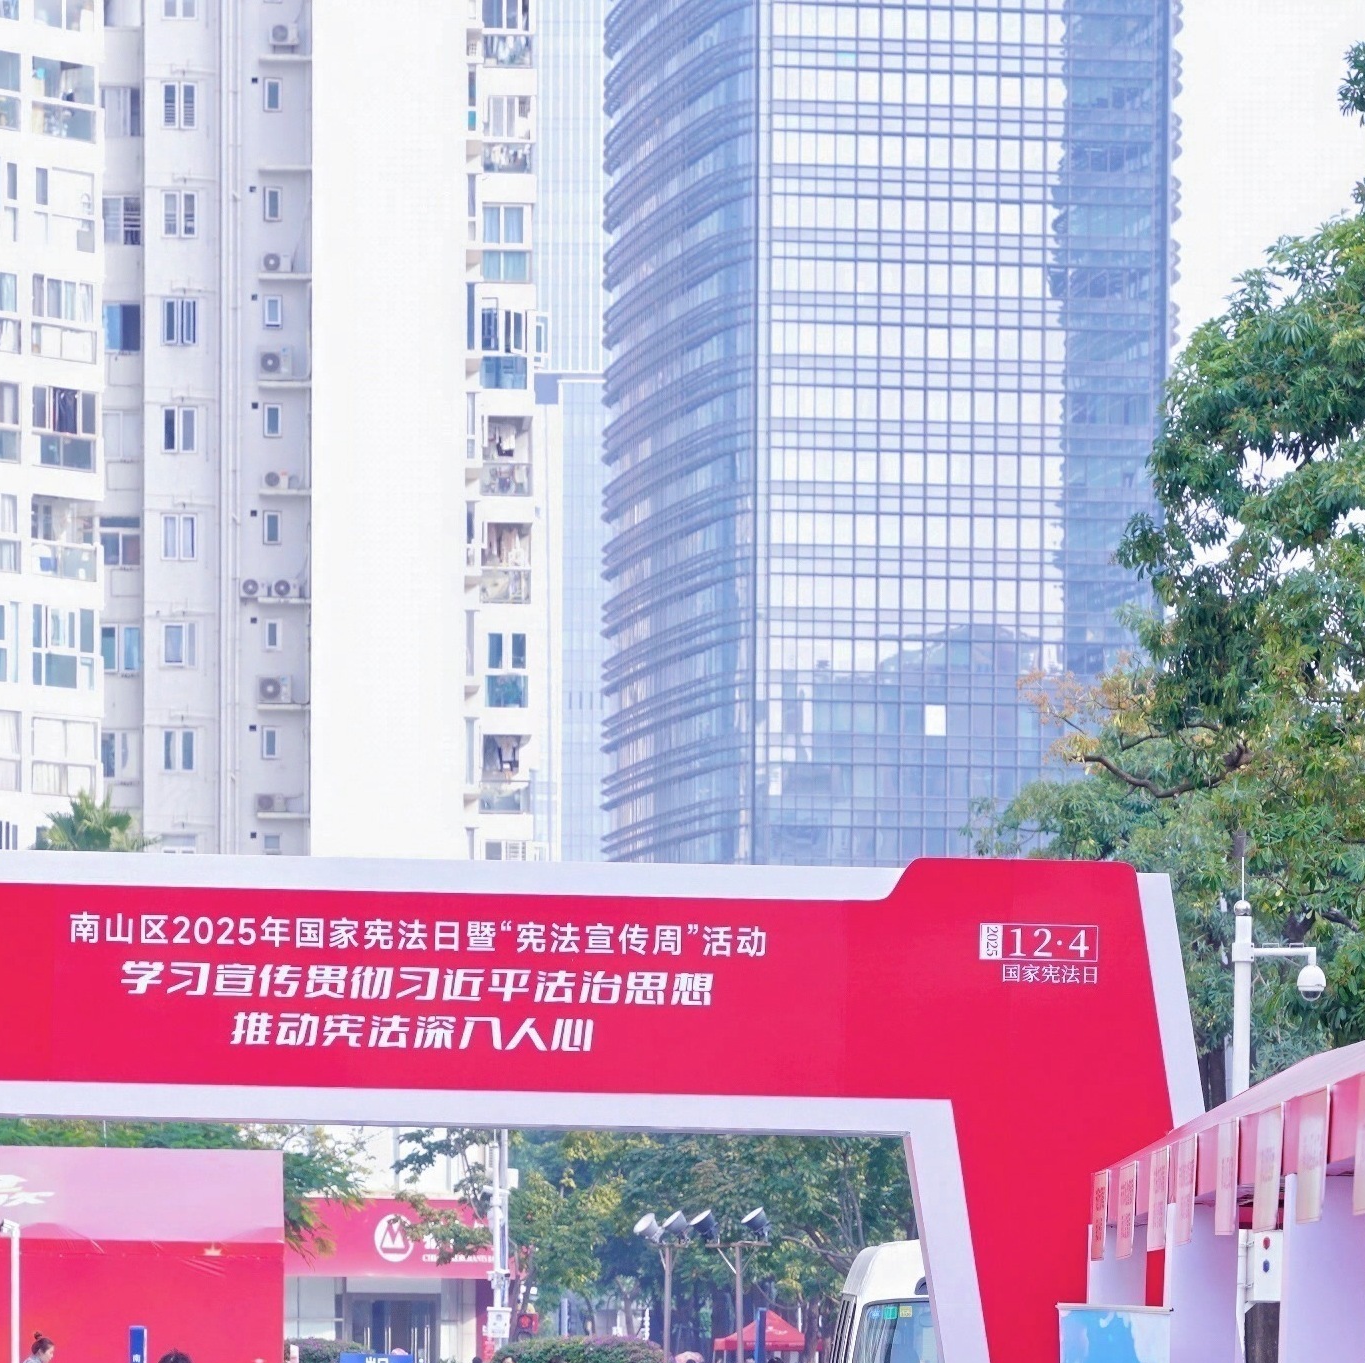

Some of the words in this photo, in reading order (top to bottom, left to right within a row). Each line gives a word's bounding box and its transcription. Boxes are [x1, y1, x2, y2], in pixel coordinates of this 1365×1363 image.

[69, 910, 768, 958] 南山区2025年国家宪法日暨“宪法宣传周”活动
[986, 926, 999, 957] 2025
[120, 960, 715, 1007] 学习宣传贯彻习近平法治思想
[1002, 963, 1098, 985] 国家宪法日
[230, 1012, 595, 1052] 推动宪法深入人心
